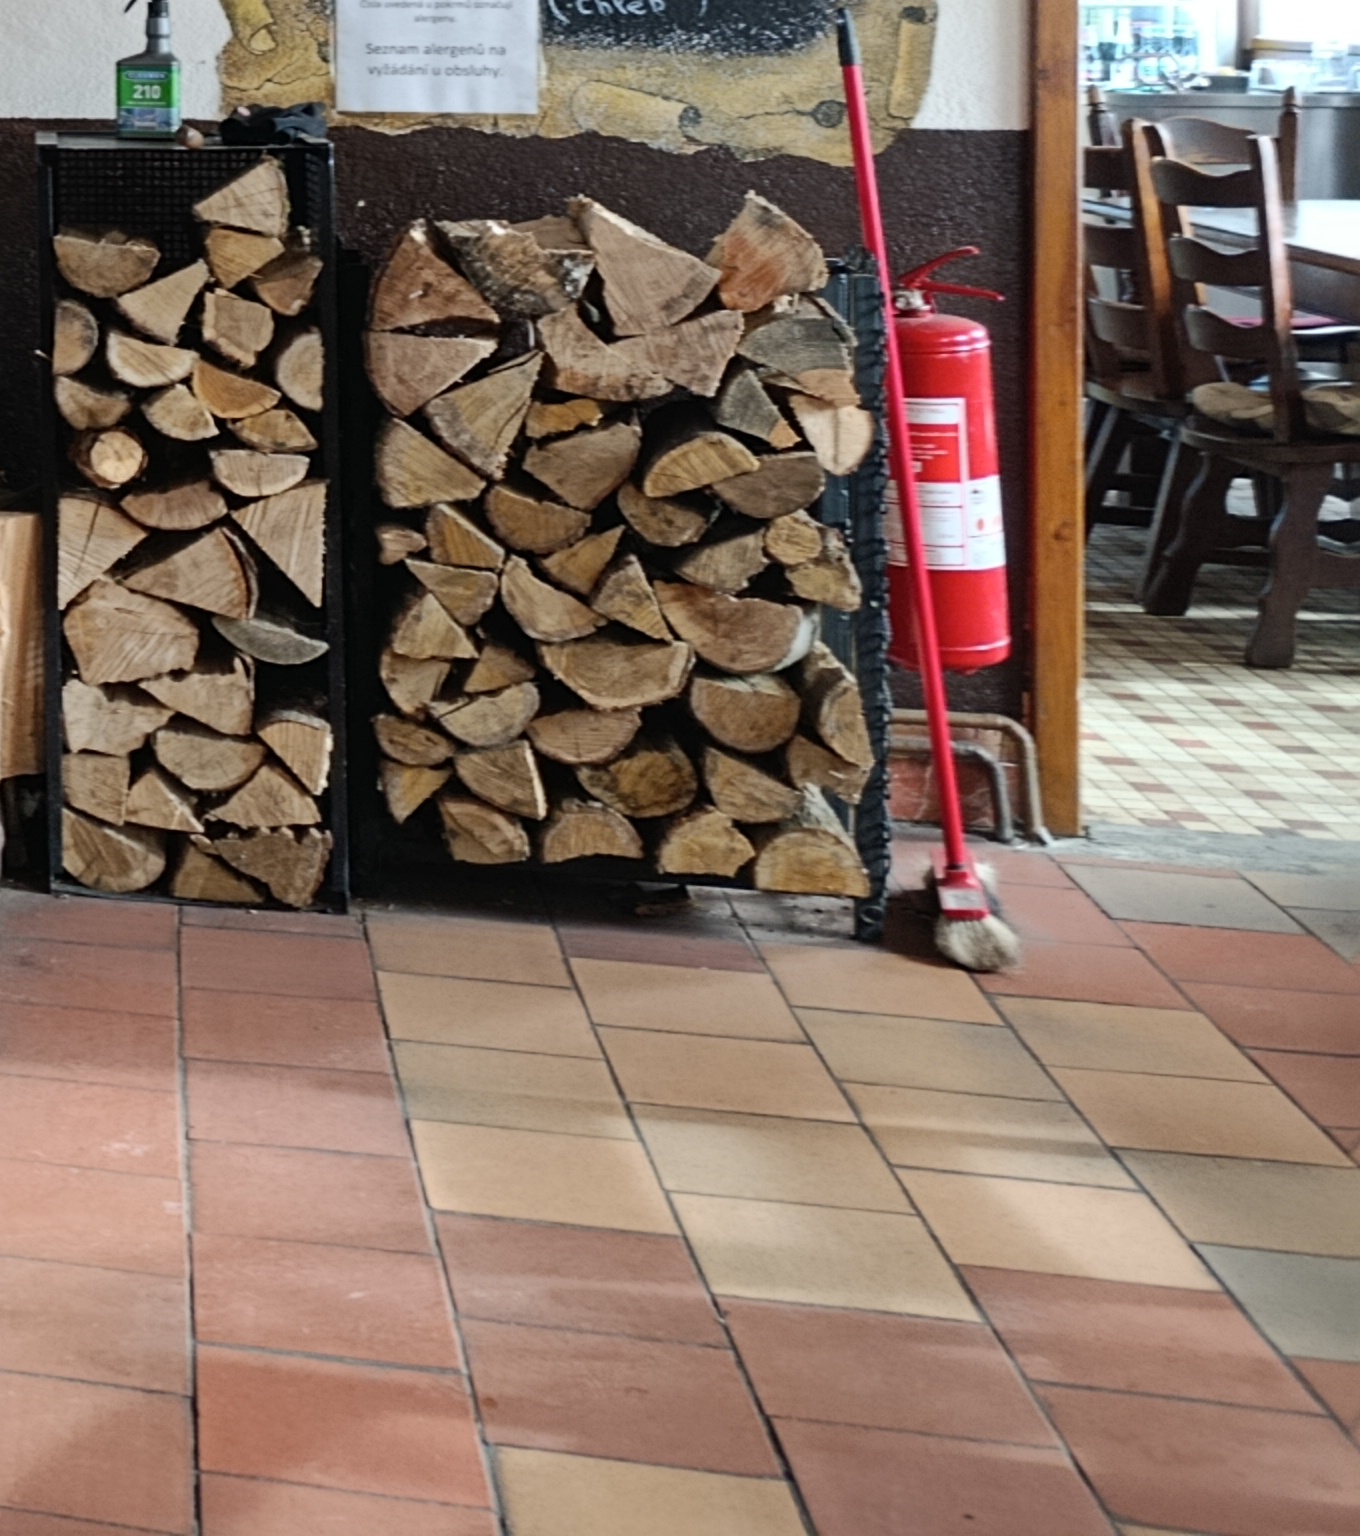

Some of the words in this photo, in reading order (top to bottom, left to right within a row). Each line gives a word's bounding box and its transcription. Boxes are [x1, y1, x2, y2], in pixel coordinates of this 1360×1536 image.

[365, 43, 419, 55] Seznam
[488, 45, 507, 56] na
[431, 66, 441, 76] u
[133, 84, 162, 100] 210
